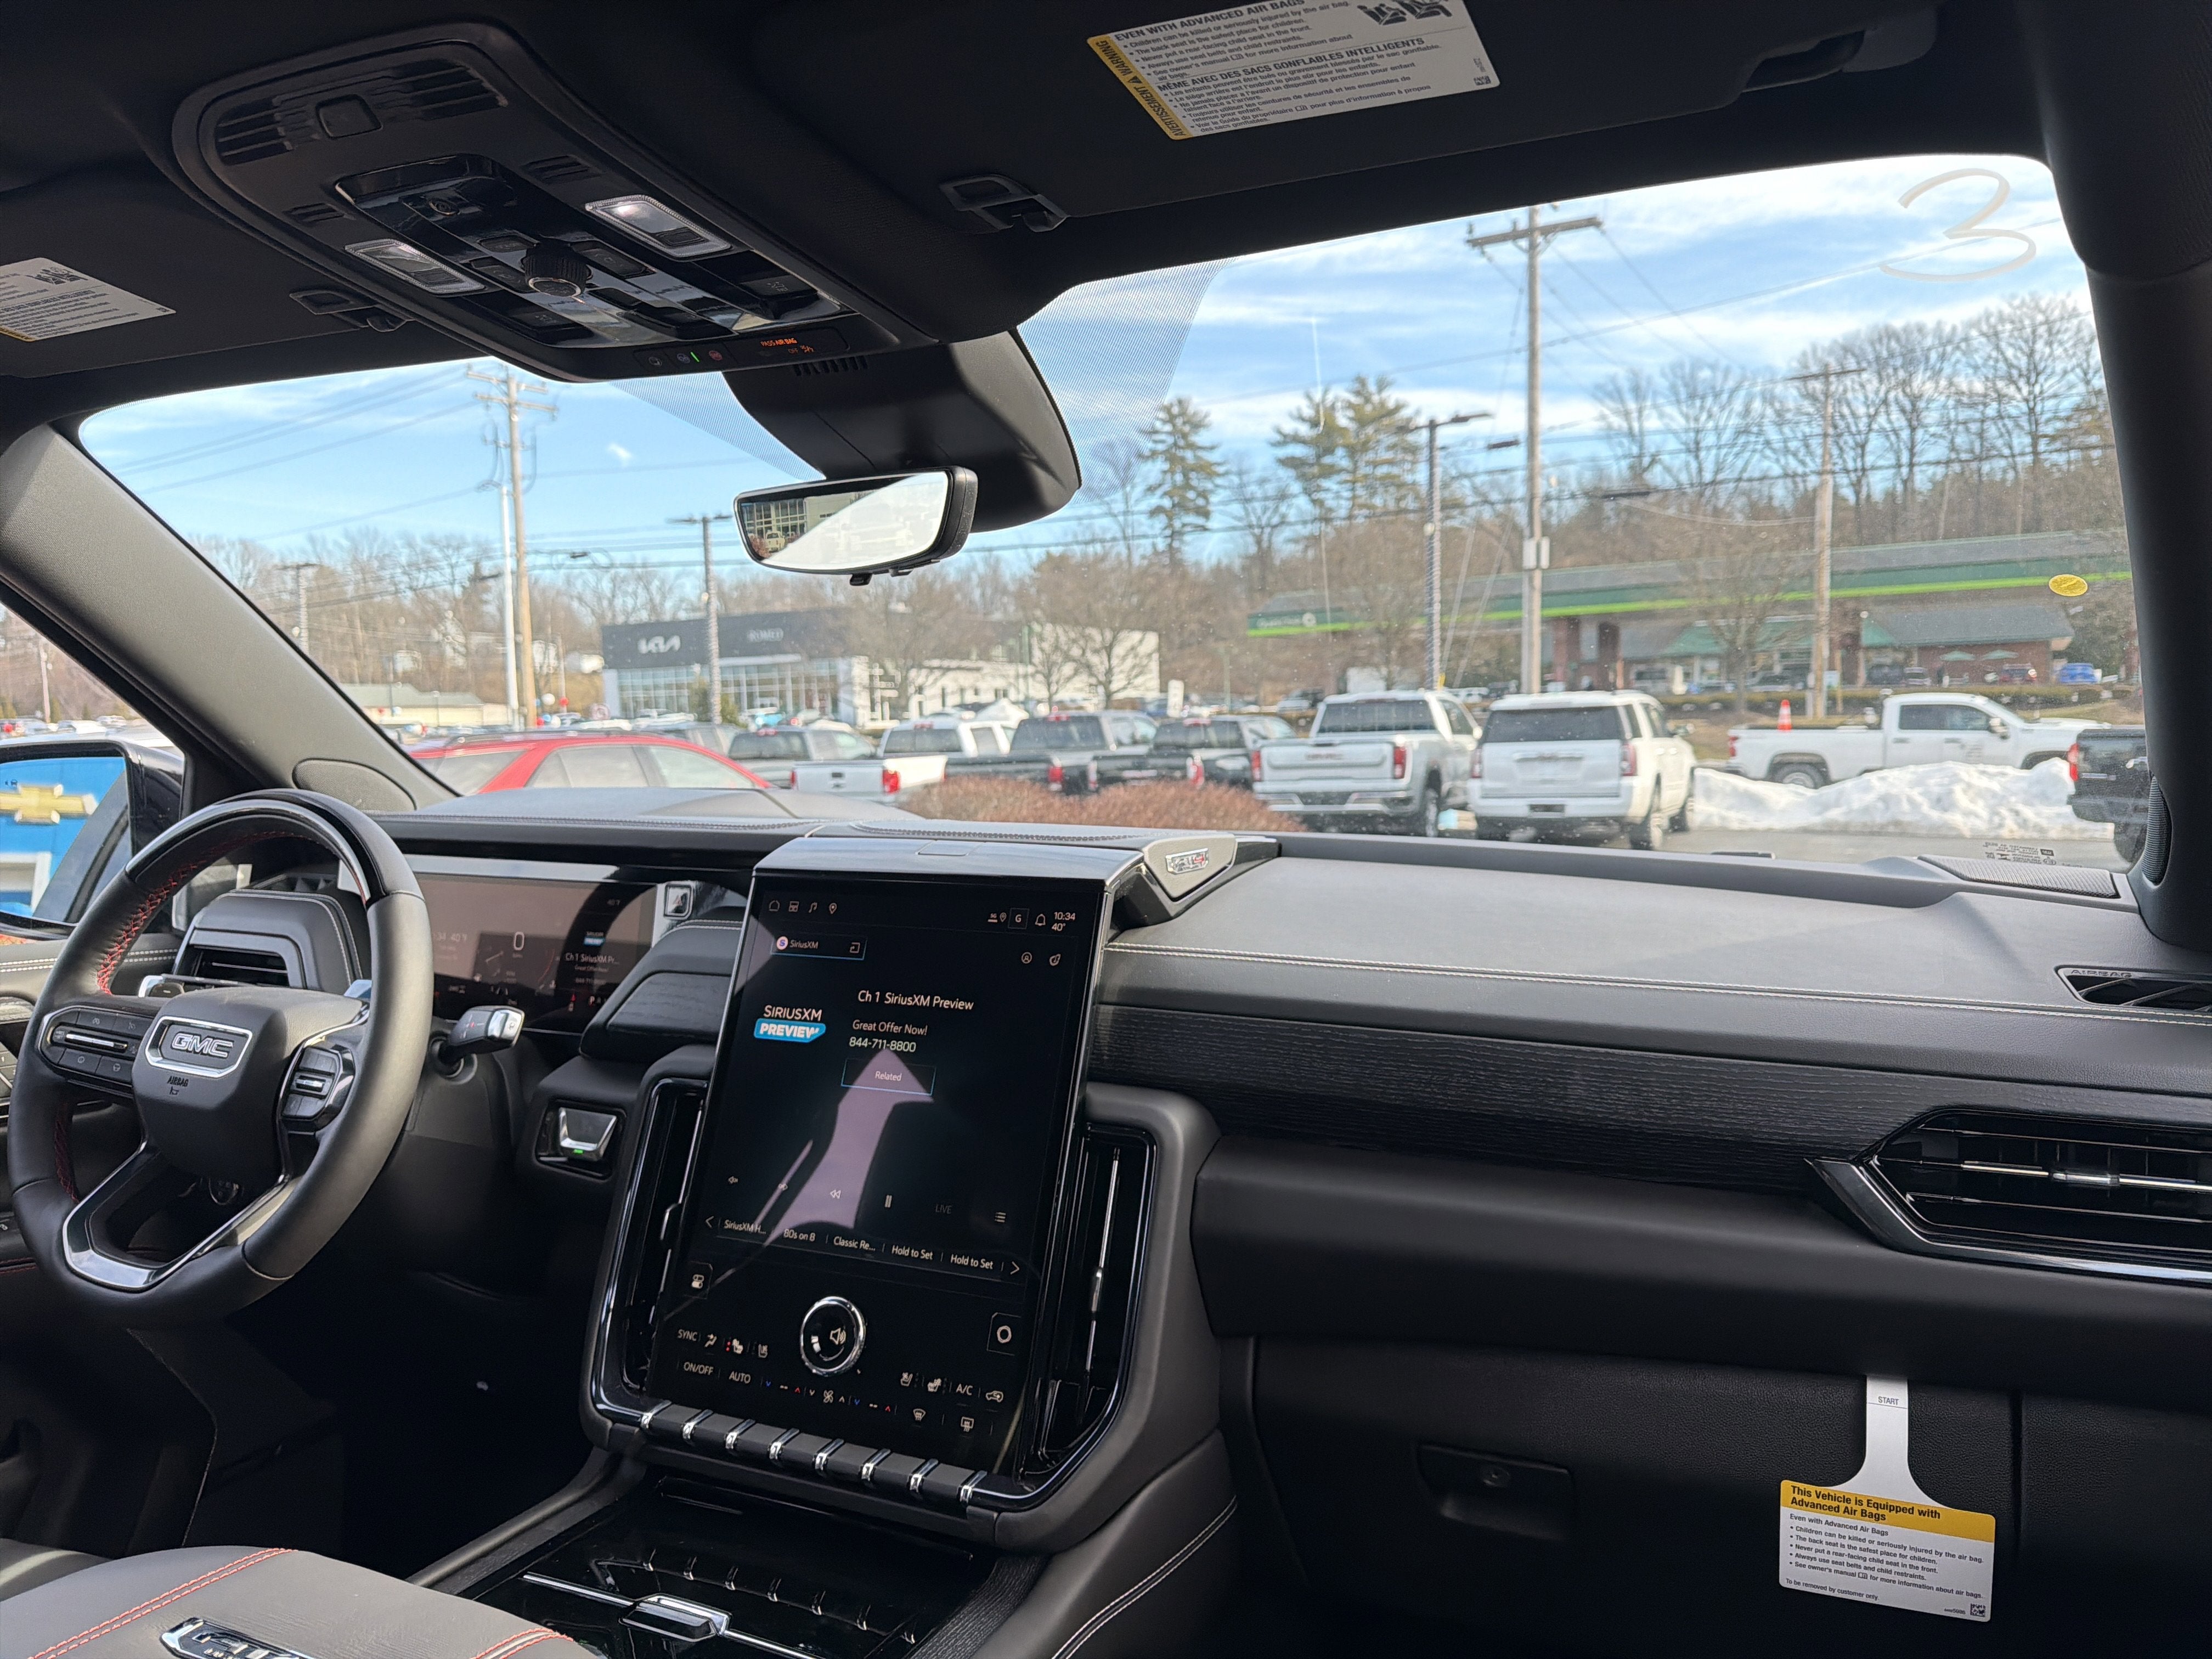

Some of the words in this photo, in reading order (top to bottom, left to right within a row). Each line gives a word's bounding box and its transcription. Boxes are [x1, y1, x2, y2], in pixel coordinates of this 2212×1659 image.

[1114, 29, 1146, 41] EVEN
[1145, 23, 1177, 34] WITH
[1180, 10, 1244, 28] ADVANCED
[1246, 5, 1268, 15] AIR
[1096, 40, 1133, 76] WARNING
[1156, 80, 1190, 92] MÊME
[1191, 75, 1218, 85] AVEC
[1218, 70, 1242, 80] DES
[1242, 65, 1272, 75] SACS
[1273, 52, 1344, 70] GONFLABLES
[1345, 37, 1425, 57] INTELLIGENTS
[1133, 86, 1186, 136] AVERTISSEMENT
[1878, 167, 2036, 283] 3
[1054, 912, 1076, 921] 10:34
[1052, 923, 1066, 931] 40°
[514, 932, 524, 950] 0
[789, 939, 819, 949] SiriusXM
[2070, 969, 2132, 978] AIRBAG
[857, 990, 872, 1002] Ch
[875, 991, 880, 1002] 1
[884, 992, 930, 1007] SiriusXM
[932, 996, 974, 1010] Preview
[763, 1005, 822, 1022] SIRIUSXM
[760, 1023, 820, 1039] PREVIEW
[853, 1019, 877, 1031] Great
[878, 1022, 902, 1033] Offer
[904, 1024, 928, 1035] Now!
[172, 1032, 234, 1058] GMC
[849, 1036, 916, 1052] 844-711-8800
[167, 1075, 189, 1087] AIRBAG
[874, 1070, 902, 1081] Related
[724, 1219, 754, 1233] SiriusXM
[783, 1229, 797, 1239] 80s
[809, 1232, 816, 1242] 8
[833, 1236, 859, 1248] Classic
[891, 1245, 910, 1256] Hold
[911, 1248, 919, 1257] to
[920, 1249, 933, 1260] Set
[950, 1254, 969, 1265] Hold
[970, 1258, 979, 1267] to
[980, 1259, 994, 1269] Set
[678, 1329, 697, 1341] SYNC
[683, 1361, 714, 1375] ON/OFF
[729, 1370, 751, 1384] AUTO
[956, 1383, 973, 1396] A/C
[1878, 1396, 1899, 1406] START
[1790, 1496, 1840, 1513] Advanced
[1842, 1506, 1858, 1516] Air
[1860, 1508, 1886, 1521] Bags
[1791, 1485, 1812, 1497] This
[1814, 1489, 1851, 1504] Vehicle
[1854, 1496, 1863, 1506] is
[1866, 1499, 1914, 1515] Equipped
[1917, 1508, 1940, 1519] with
[1790, 1513, 1806, 1522] Even
[1824, 1519, 1858, 1531] Advanced
[1871, 1527, 1888, 1536] Bags
[1795, 1526, 1822, 1536] Children
[1848, 1534, 1866, 1543] killed
[1877, 1541, 1907, 1551] seriously
[1909, 1545, 1933, 1554] injured
[1969, 1555, 1983, 1564] bag.
[1808, 1537, 1824, 1545] back
[1909, 1555, 1937, 1565] children.
[1795, 1543, 1813, 1551] Never
[1832, 1551, 1867, 1562] rear-facing
[1921, 1565, 1938, 1573] front.
[1795, 1553, 1817, 1561] Always
[1894, 1571, 1926, 1581] restraints.
[1802, 1582, 1827, 1591] removed
[1837, 1588, 1864, 1597] customer
[1807, 1565, 1832, 1573] owner's
[1898, 1579, 1934, 1590] information
[1966, 1590, 1983, 1599] bags.
